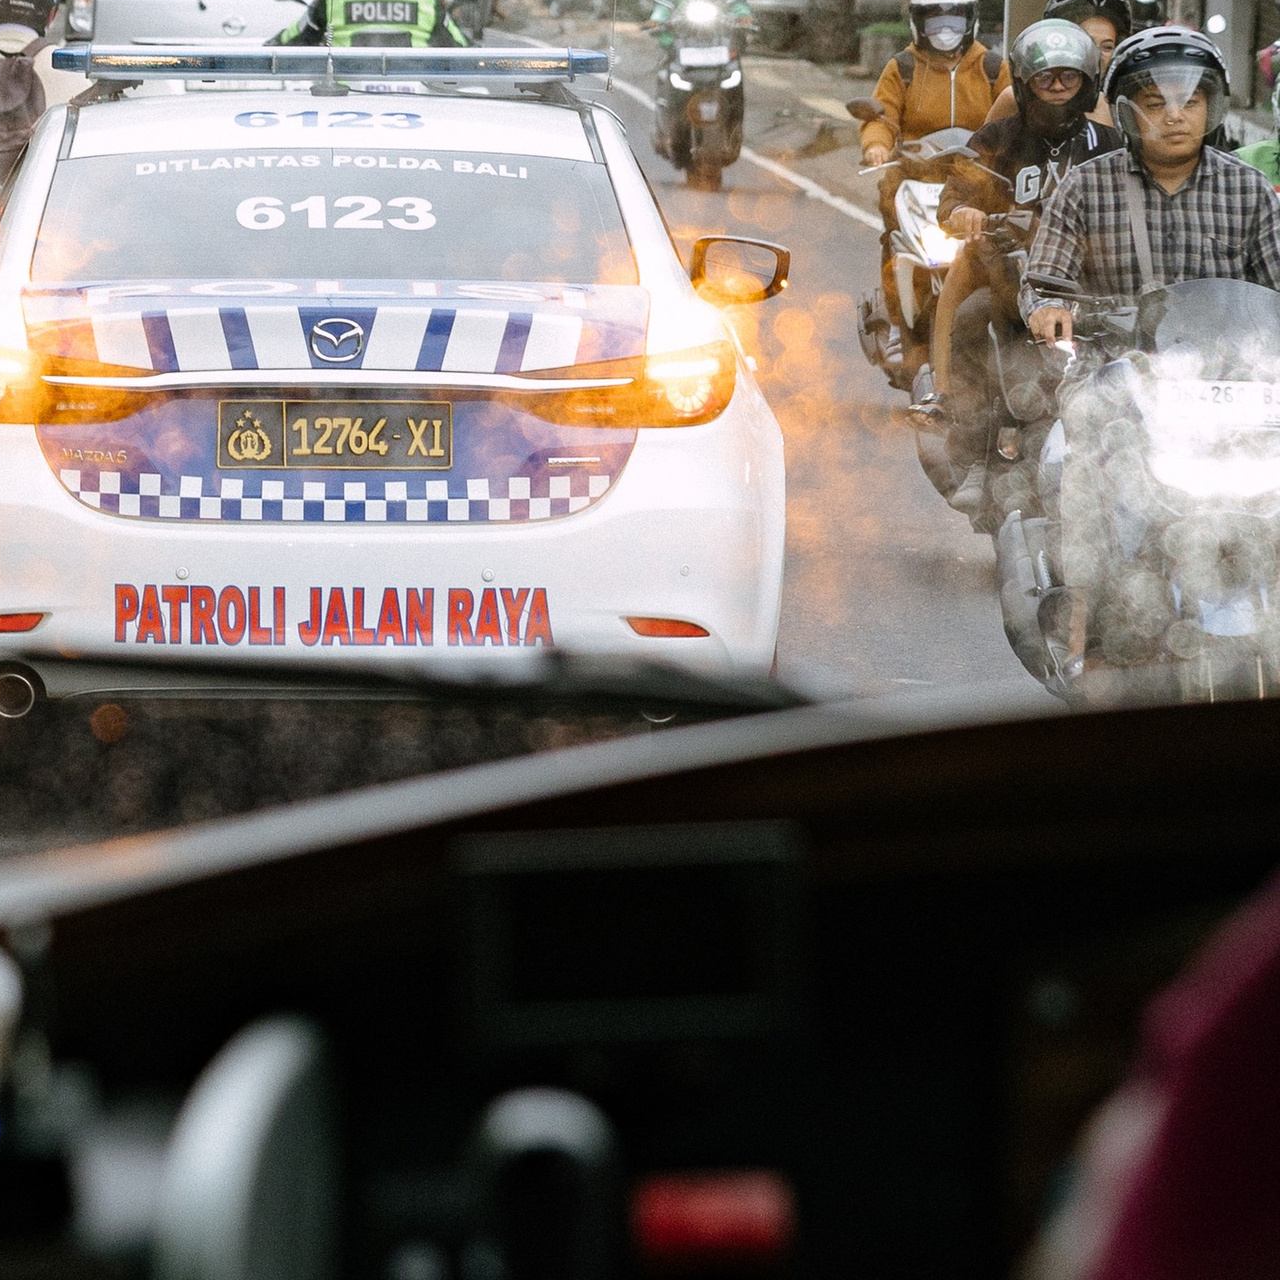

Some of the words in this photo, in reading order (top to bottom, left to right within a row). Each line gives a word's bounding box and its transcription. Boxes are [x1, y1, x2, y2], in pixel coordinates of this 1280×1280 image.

[351, 2, 411, 22] POLISI
[235, 111, 425, 130] 6123
[135, 155, 320, 176] DITLANTAS
[332, 155, 442, 172] POLDA
[453, 160, 528, 180] BALI
[235, 195, 437, 231] 6123
[114, 583, 287, 646] PATROLI
[298, 586, 435, 647] JALAN
[447, 587, 555, 647] RAYA
